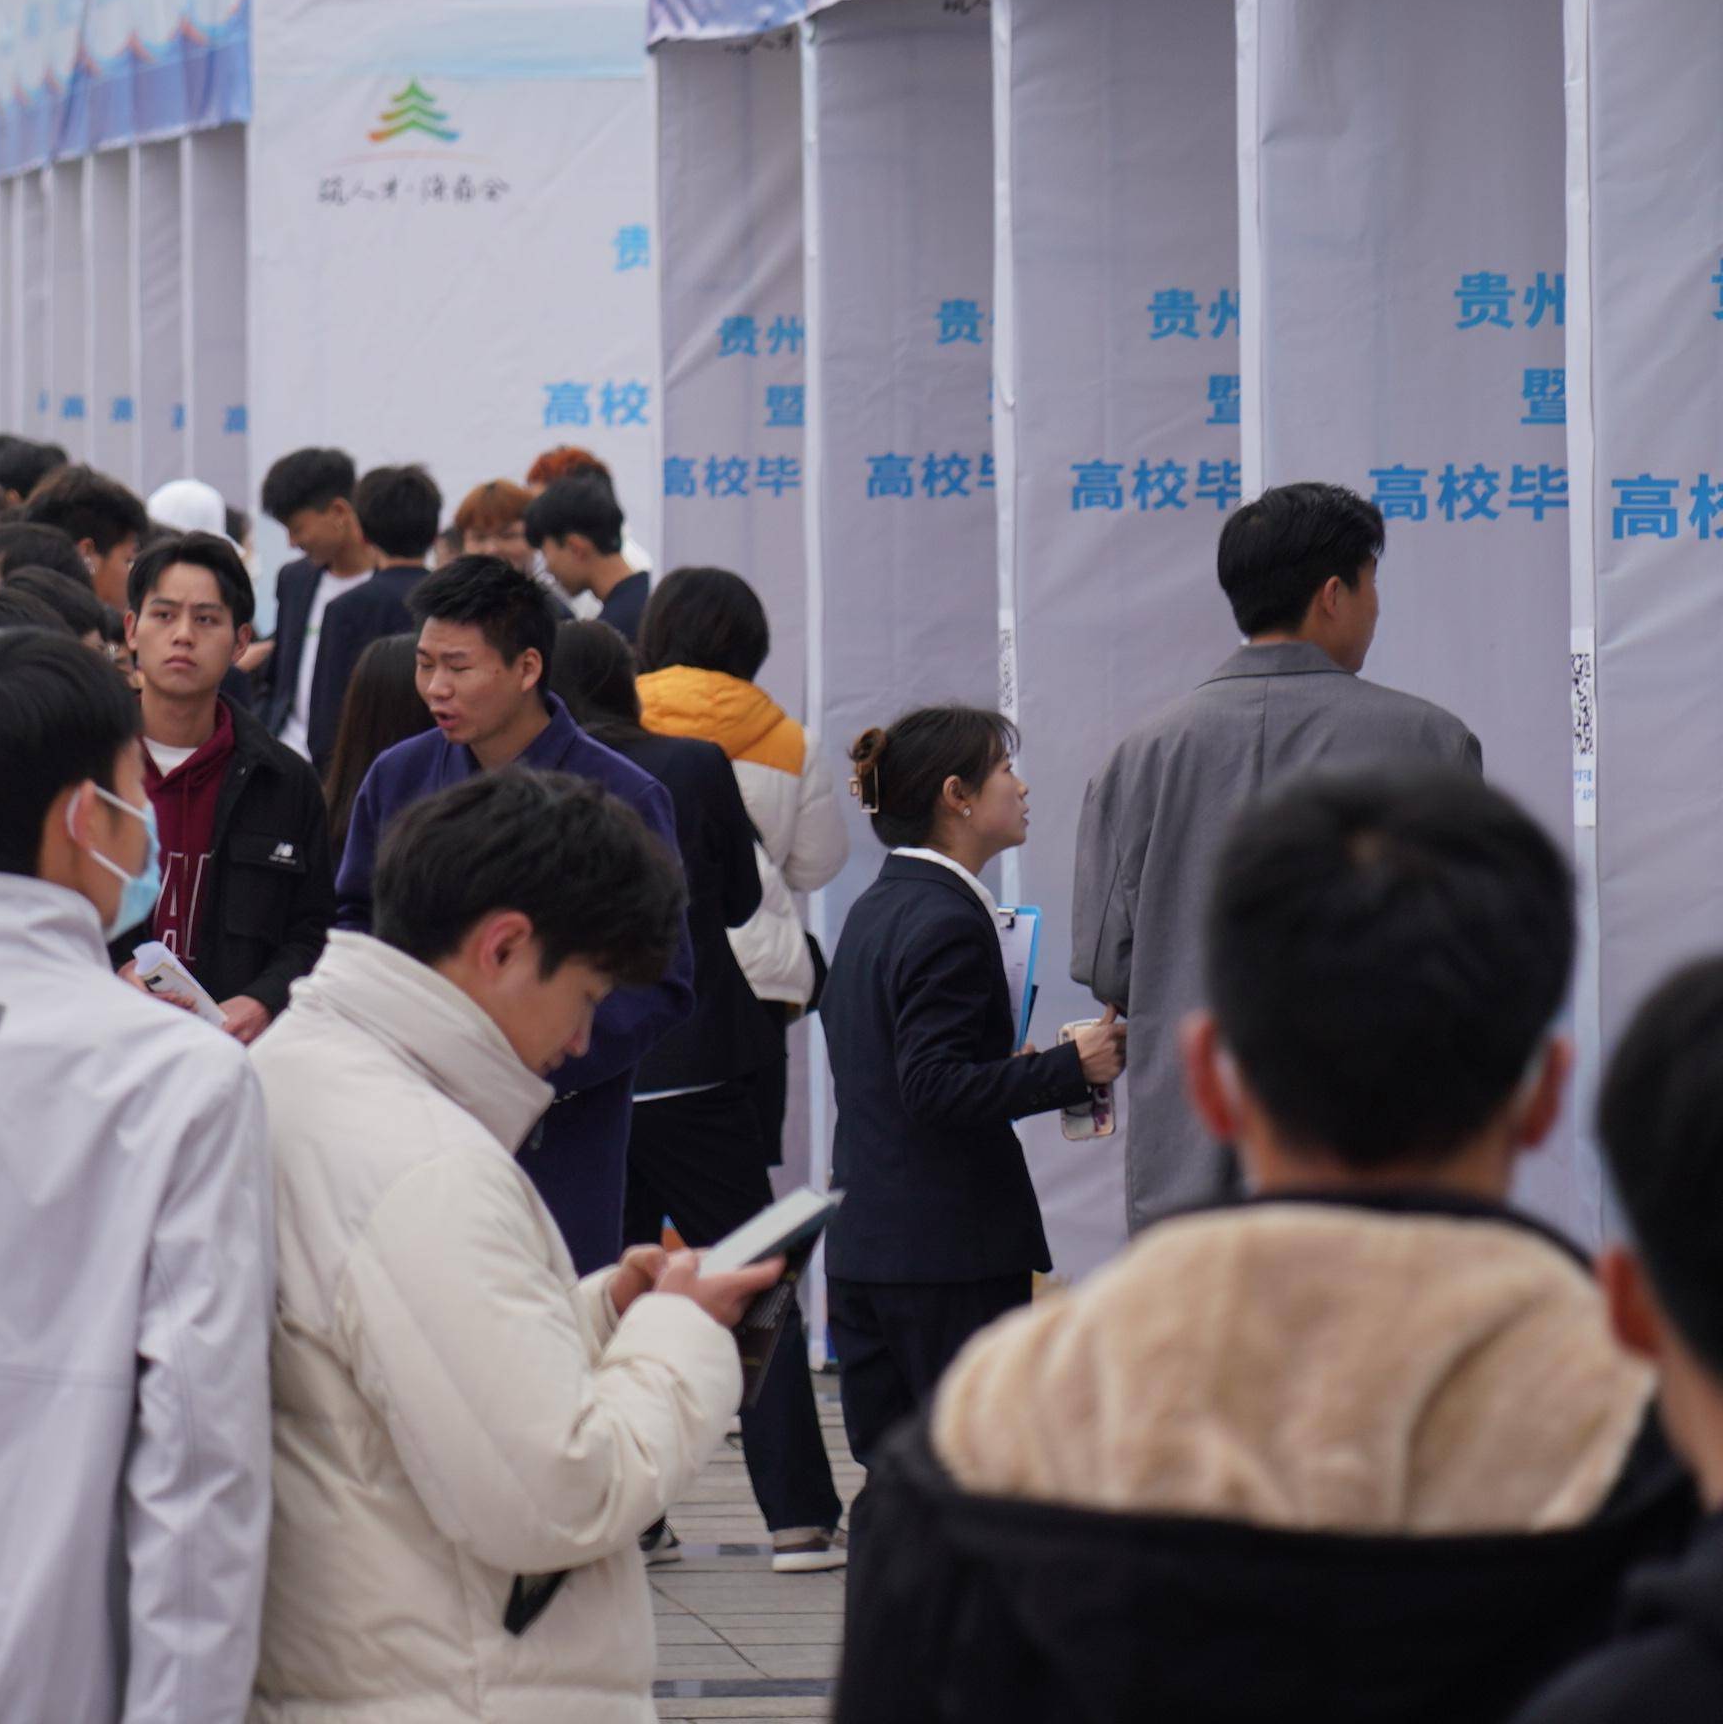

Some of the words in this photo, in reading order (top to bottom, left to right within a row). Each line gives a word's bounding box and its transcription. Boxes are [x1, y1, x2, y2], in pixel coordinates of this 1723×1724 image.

[934, 298, 993, 345] 贵
[1455, 271, 1566, 329] 贵州
[716, 315, 806, 357] 贵州
[542, 381, 649, 426] 高校
[663, 456, 802, 497] 高校毕
[1070, 459, 1242, 511] 高校毕
[1368, 463, 1569, 522] 高校毕
